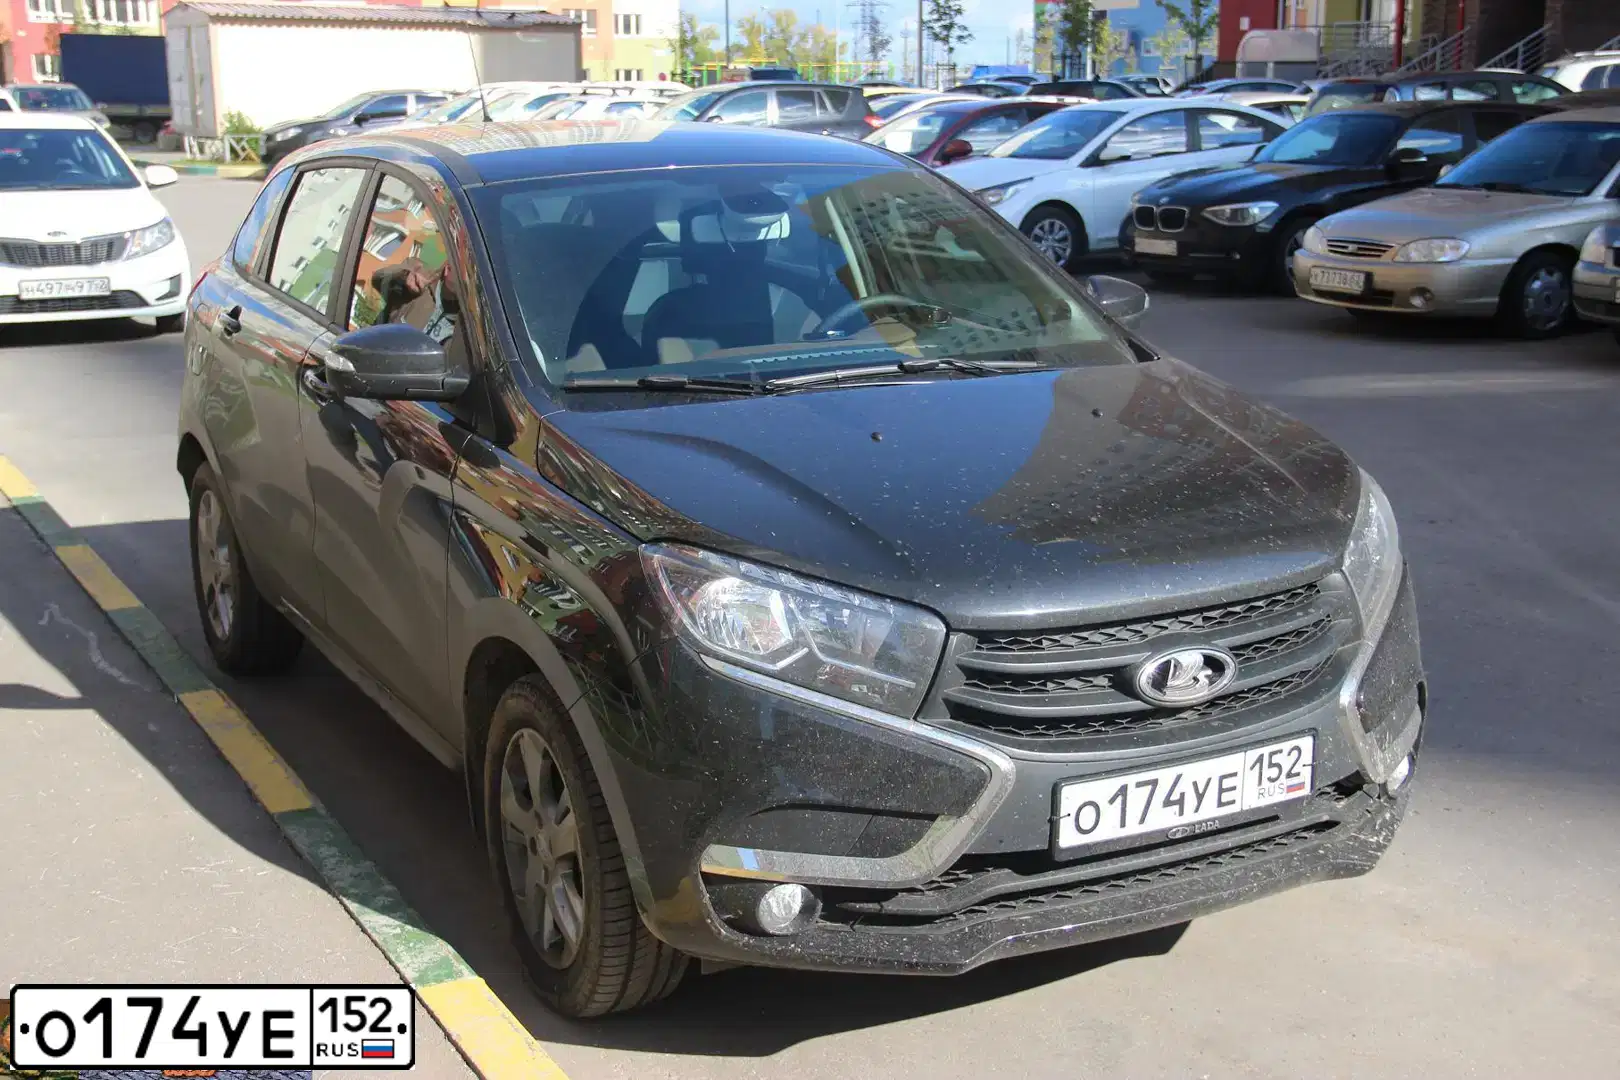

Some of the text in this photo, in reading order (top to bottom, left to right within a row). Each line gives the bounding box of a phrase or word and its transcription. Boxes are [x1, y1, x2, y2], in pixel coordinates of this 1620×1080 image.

[1249, 745, 1303, 786] 152
[1258, 784, 1285, 799] RUS
[1194, 819, 1221, 833] LADA
